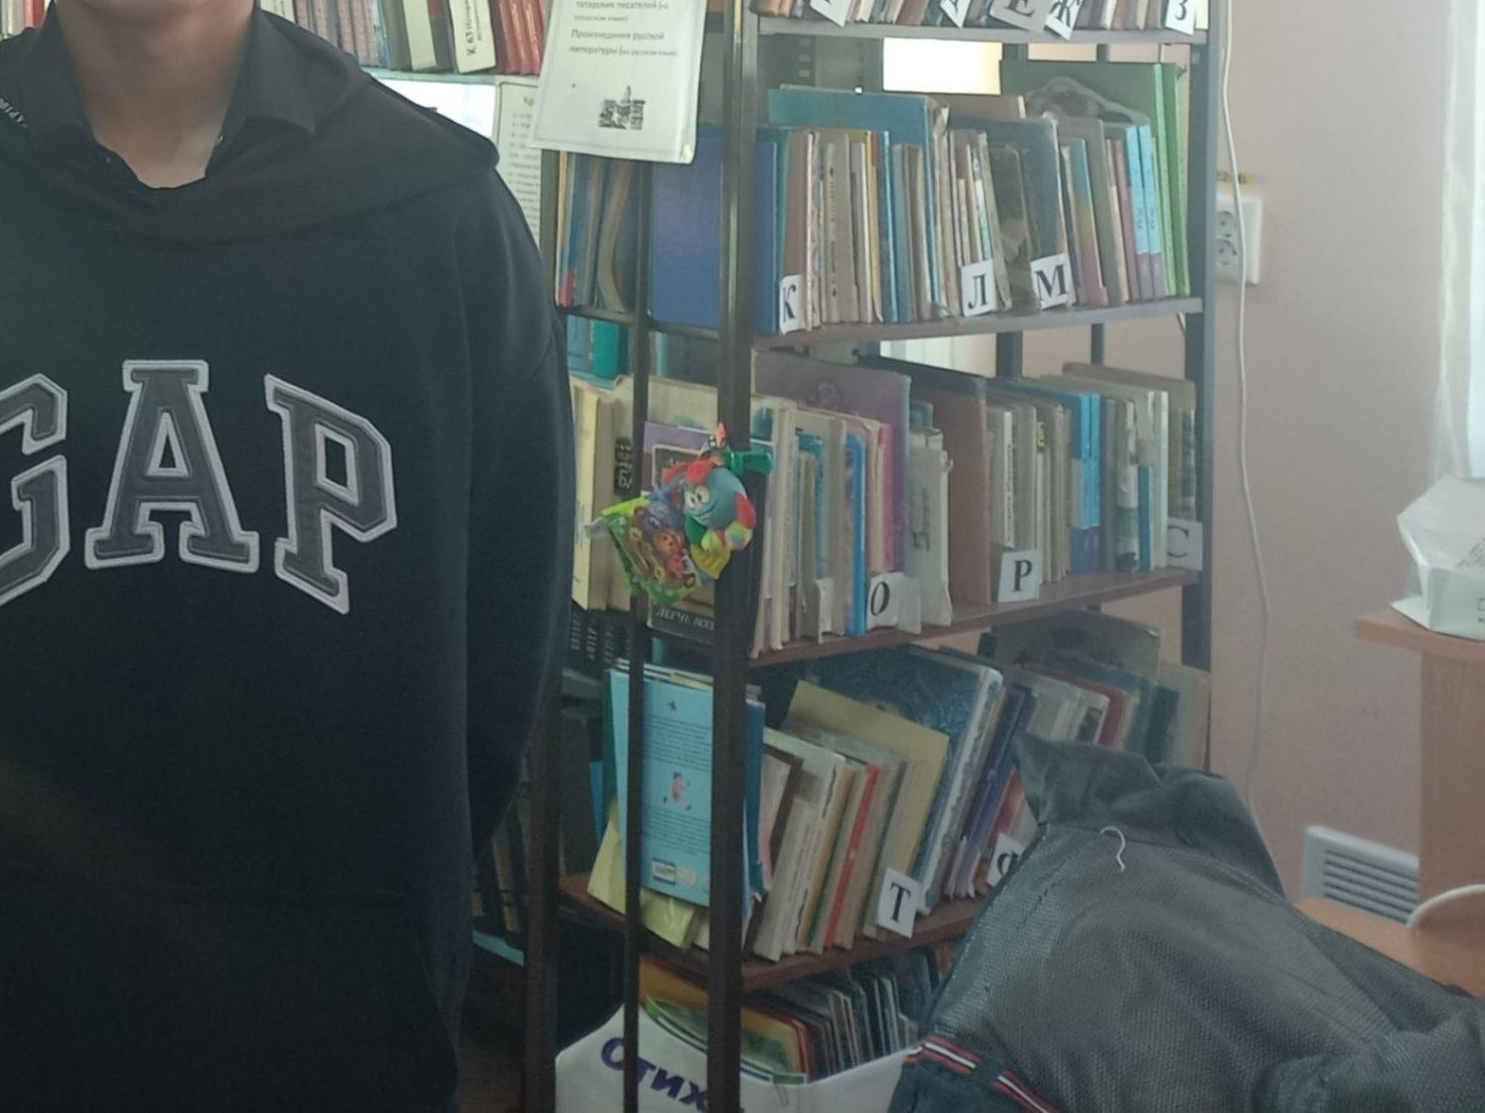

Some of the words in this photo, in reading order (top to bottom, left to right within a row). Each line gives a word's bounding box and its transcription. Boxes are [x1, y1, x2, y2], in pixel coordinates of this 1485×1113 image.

[779, 283, 797, 322] К
[966, 275, 989, 308] Л
[1034, 264, 1070, 305] М
[1167, 523, 1190, 560] С
[1012, 559, 1033, 592] Р
[870, 581, 891, 617] О
[888, 881, 915, 925] Т
